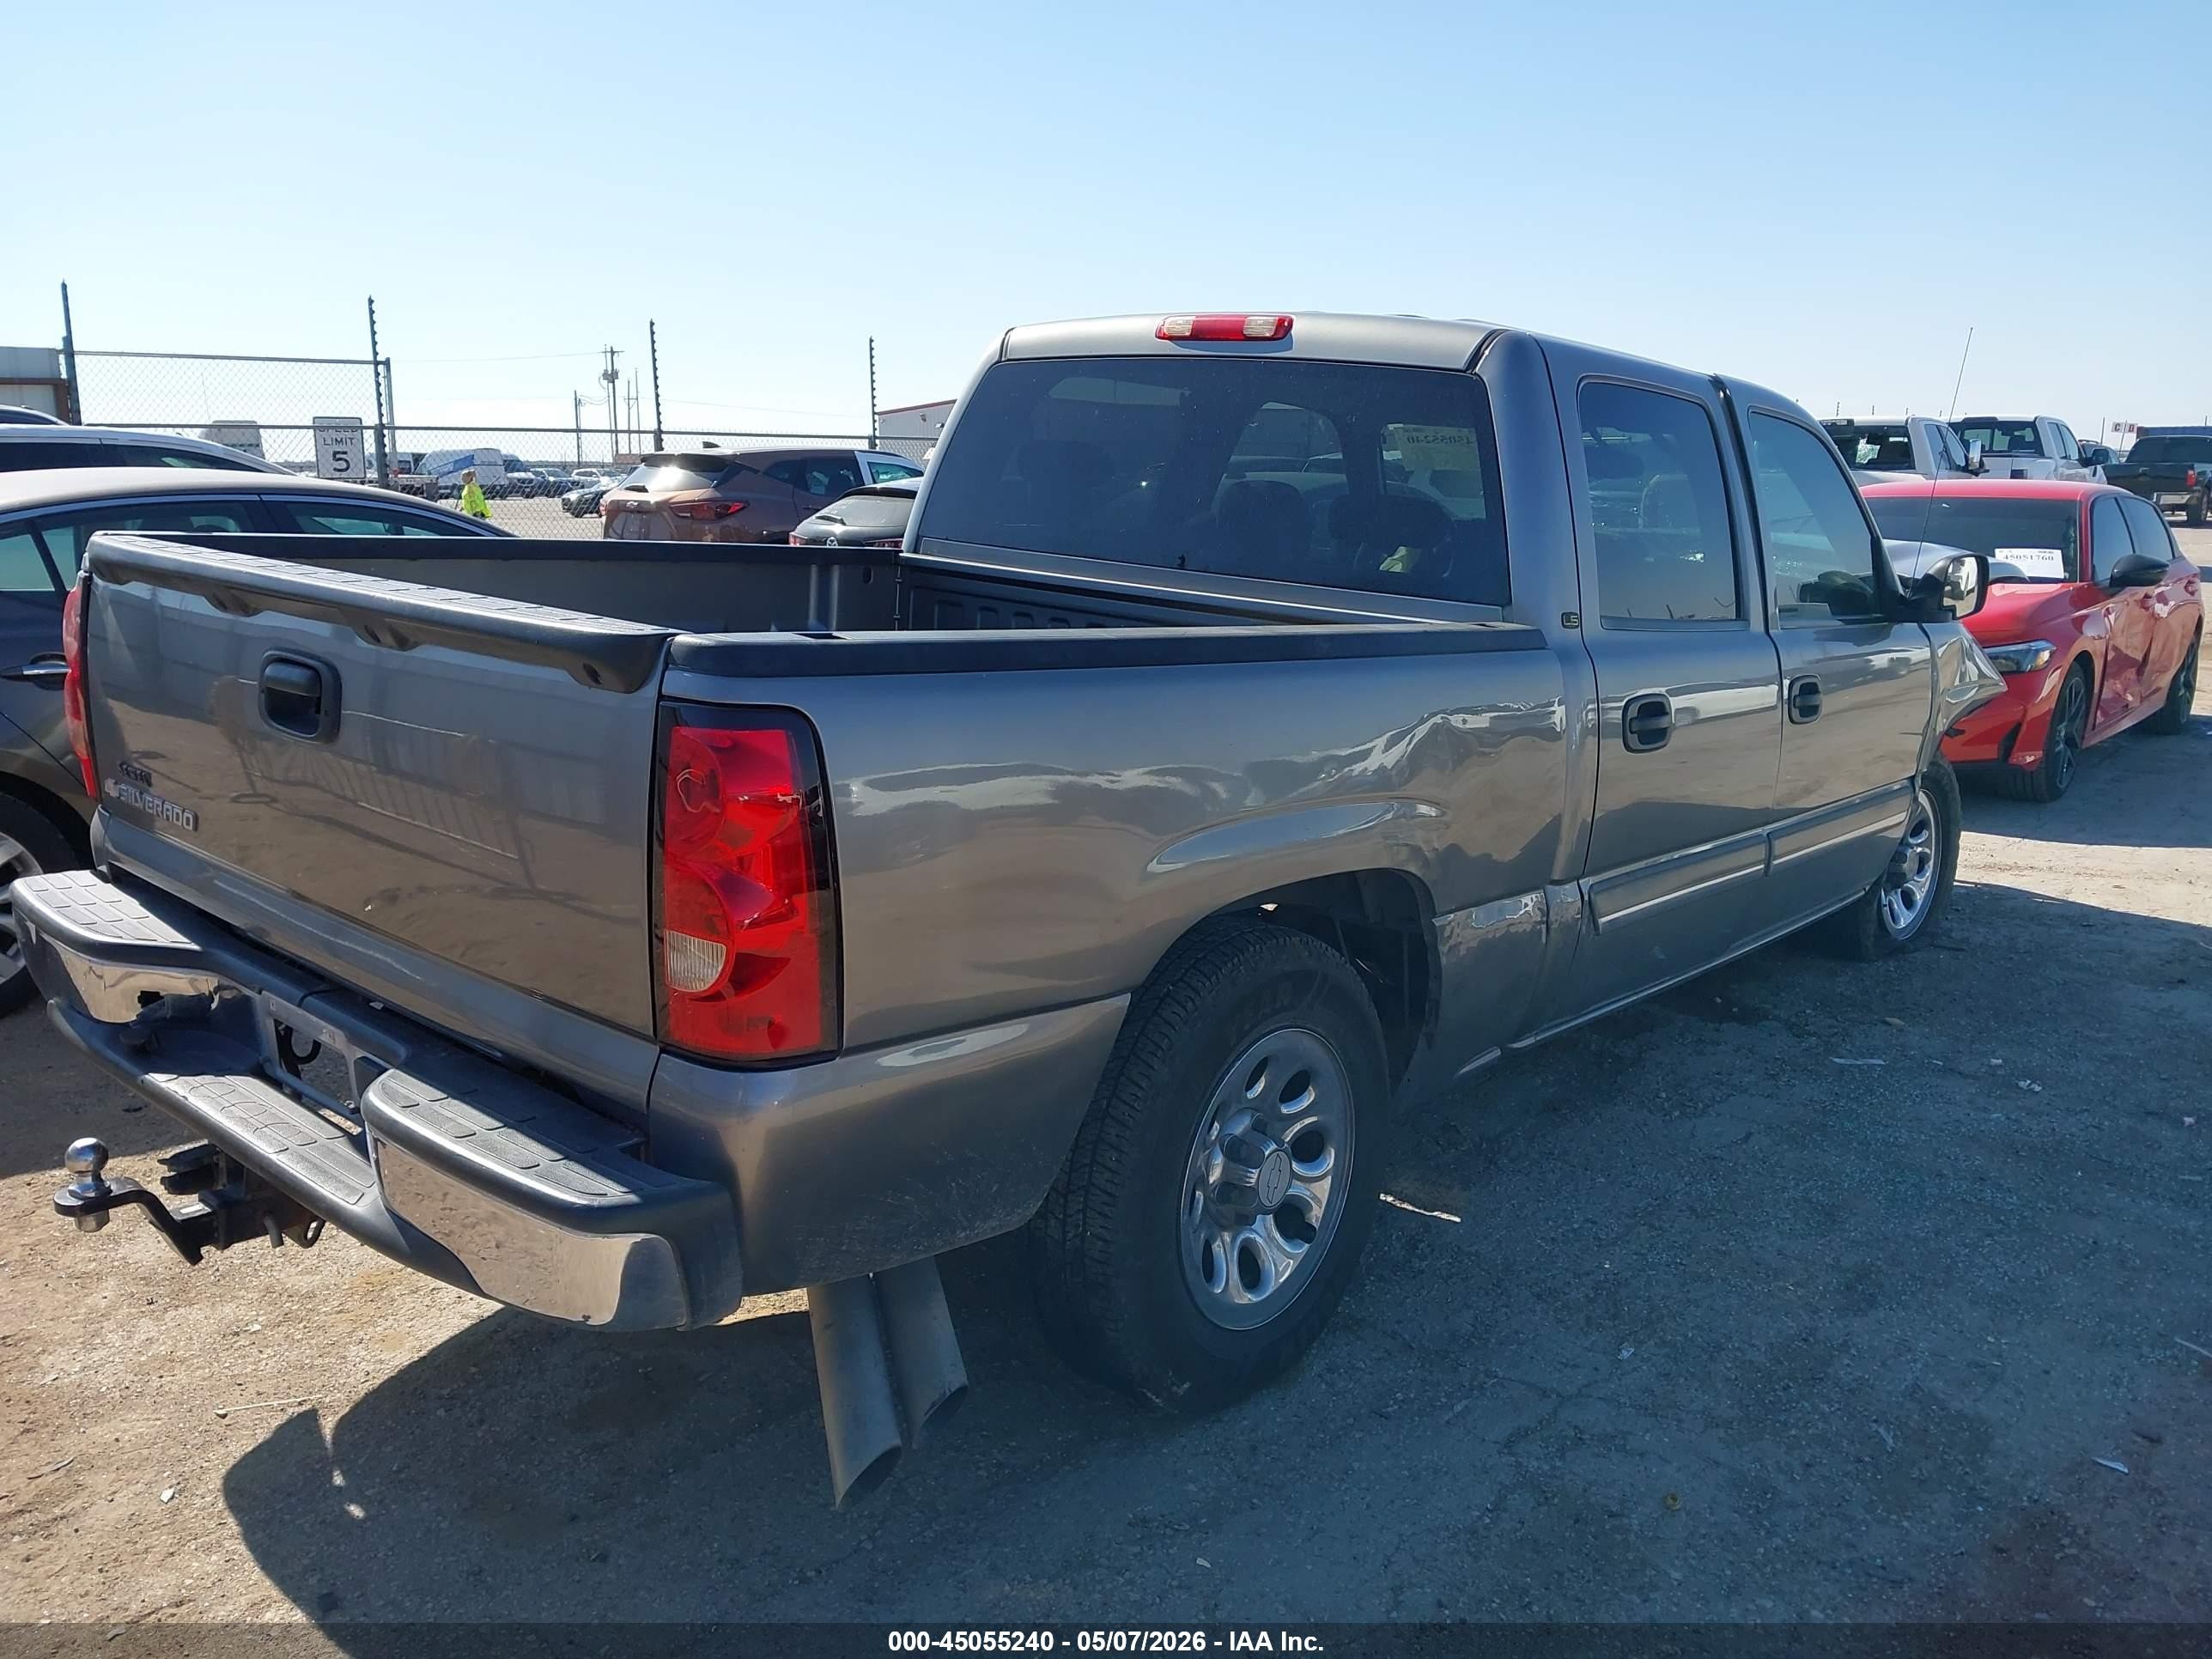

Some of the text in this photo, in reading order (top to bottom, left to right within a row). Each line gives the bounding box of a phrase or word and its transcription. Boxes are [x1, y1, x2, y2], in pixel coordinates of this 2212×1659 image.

[323, 437, 356, 447] LIMIT
[332, 451, 350, 472] 5
[1563, 614, 1578, 626] LS
[118, 783, 194, 832] SILVERADO
